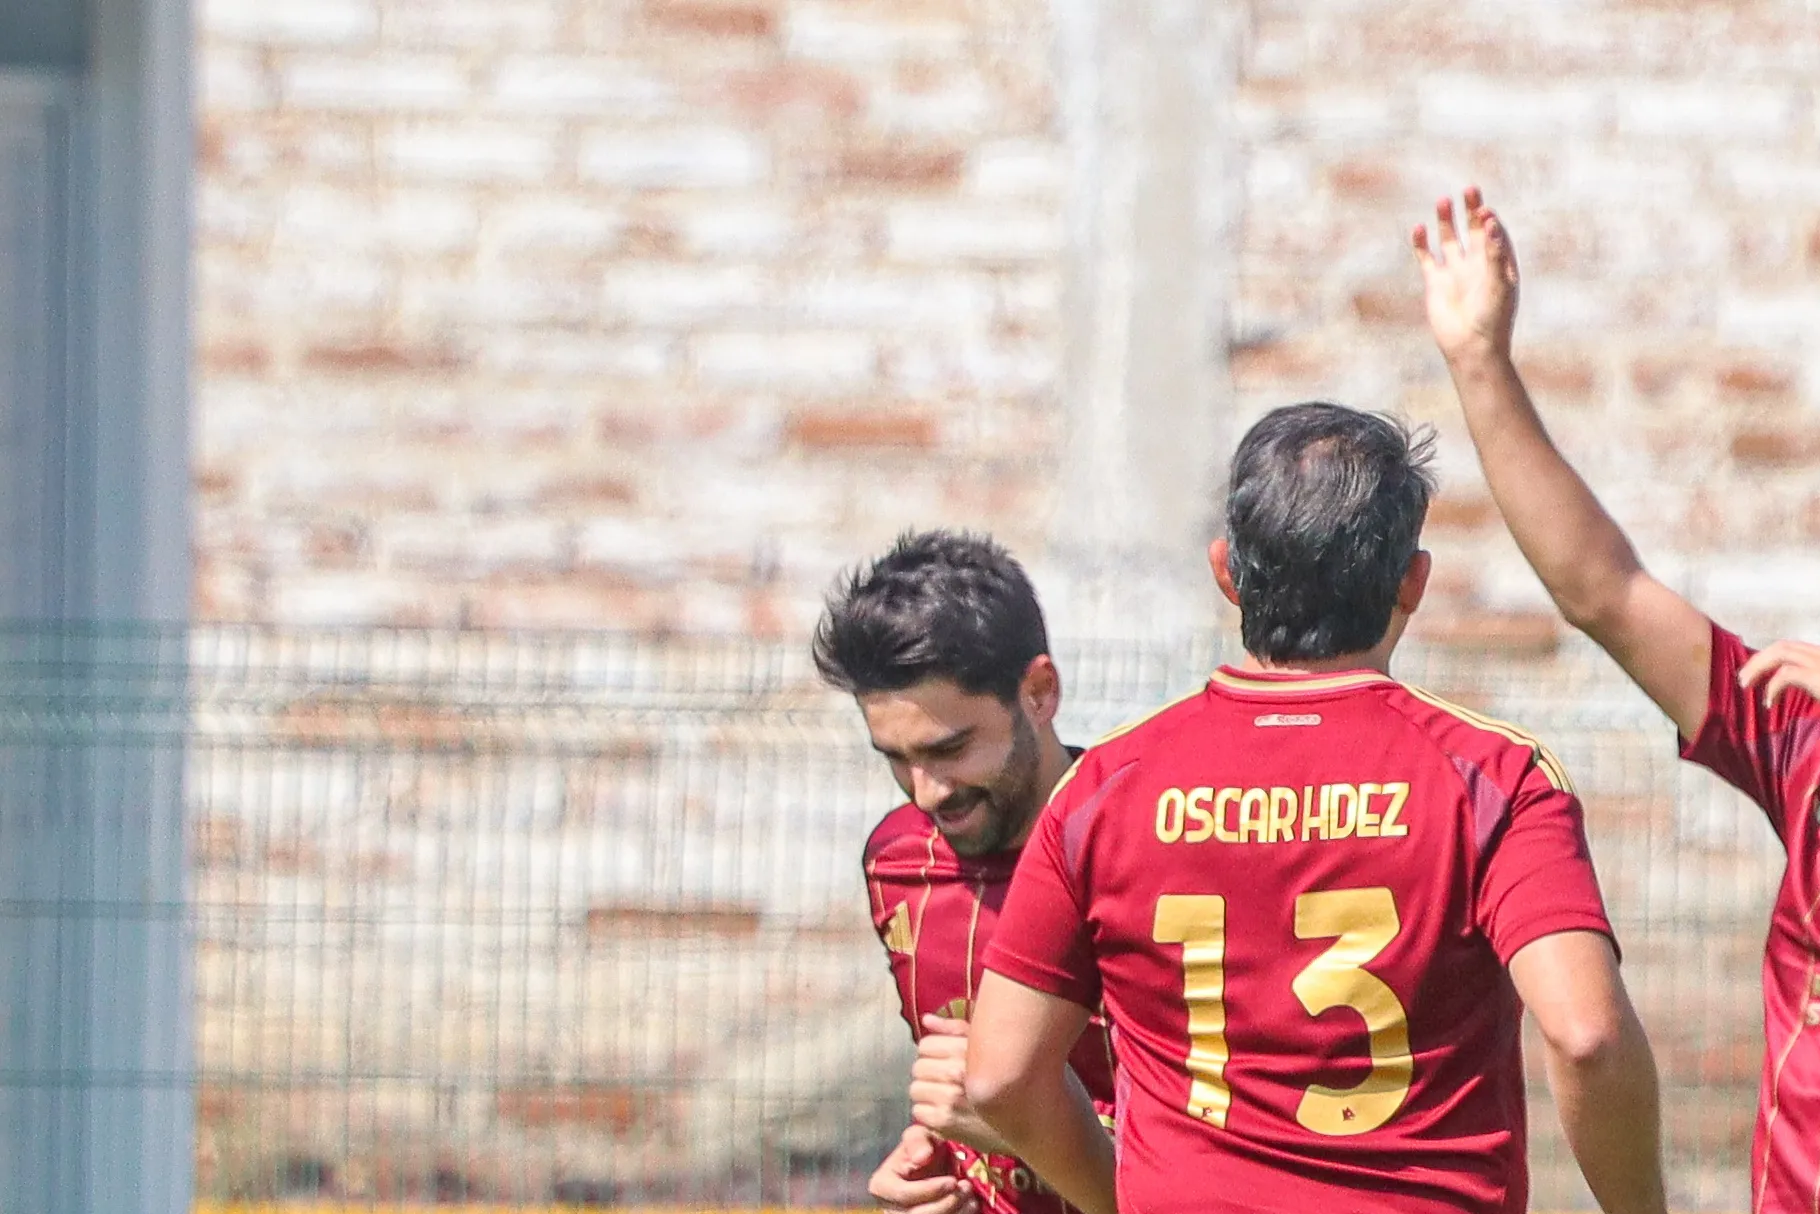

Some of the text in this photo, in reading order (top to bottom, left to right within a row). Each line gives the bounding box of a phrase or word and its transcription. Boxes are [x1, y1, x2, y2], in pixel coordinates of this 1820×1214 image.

[1155, 782, 1410, 844] OSCAR HDEZ
[1152, 886, 1414, 1136] 13
